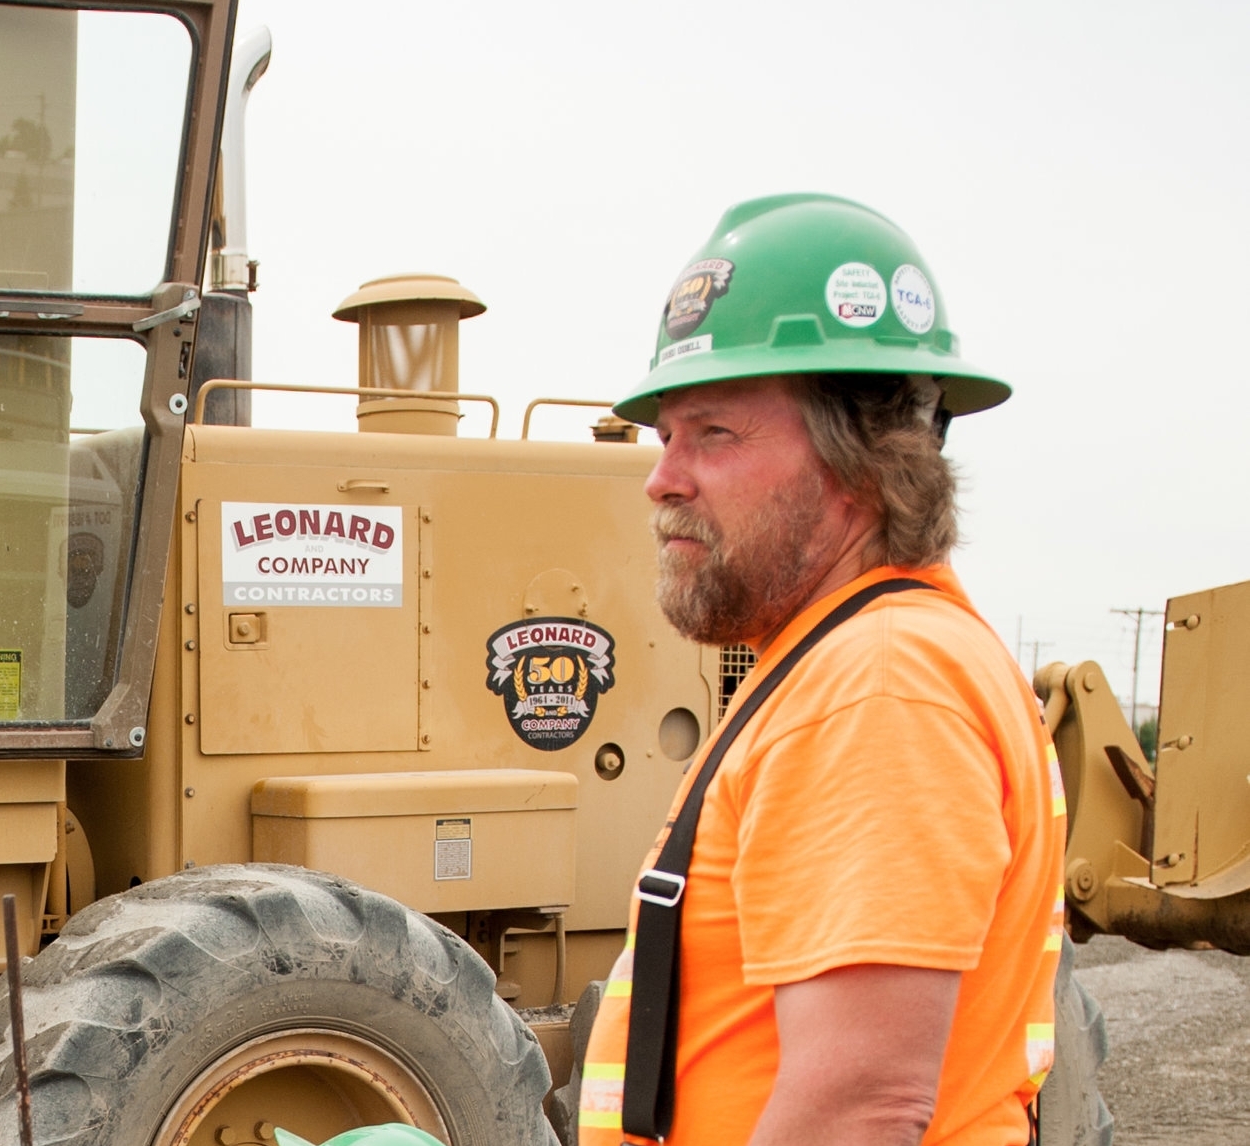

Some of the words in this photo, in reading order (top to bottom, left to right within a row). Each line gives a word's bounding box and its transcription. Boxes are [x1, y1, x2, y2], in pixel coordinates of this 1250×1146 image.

[232, 509, 395, 552] LEONARD
[304, 544, 324, 553] AND
[257, 557, 370, 575] COMPANY
[233, 586, 395, 602] CONTRACTORS
[506, 627, 596, 650] LEONARD
[527, 656, 575, 684] 50
[530, 685, 573, 693] YEARS
[521, 719, 580, 731] COMPANY
[527, 731, 575, 740] CONTRACTORS
